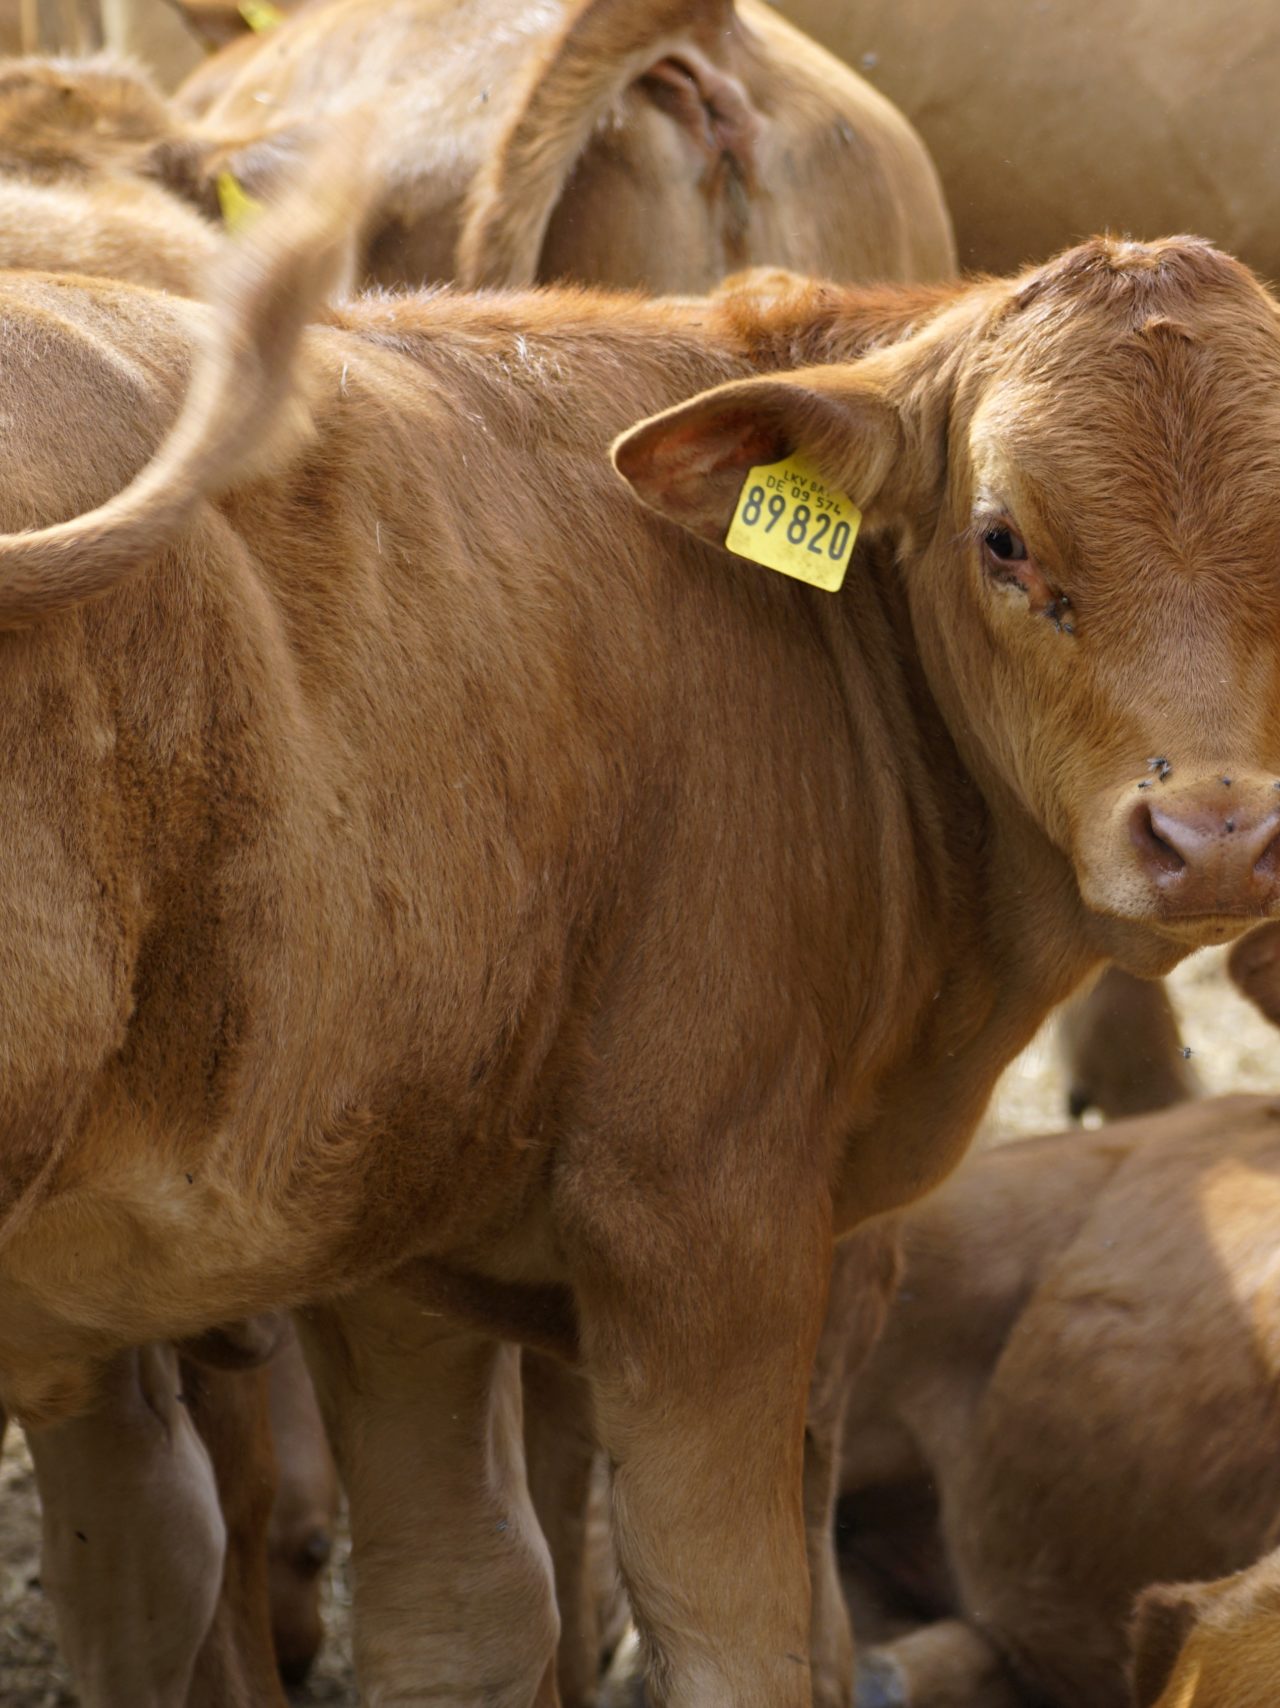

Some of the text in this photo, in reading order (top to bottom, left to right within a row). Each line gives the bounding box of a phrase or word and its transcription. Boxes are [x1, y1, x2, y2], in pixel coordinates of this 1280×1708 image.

[767, 475, 786, 493] DE
[791, 487, 810, 502] 09
[784, 470, 829, 497] LKV BA
